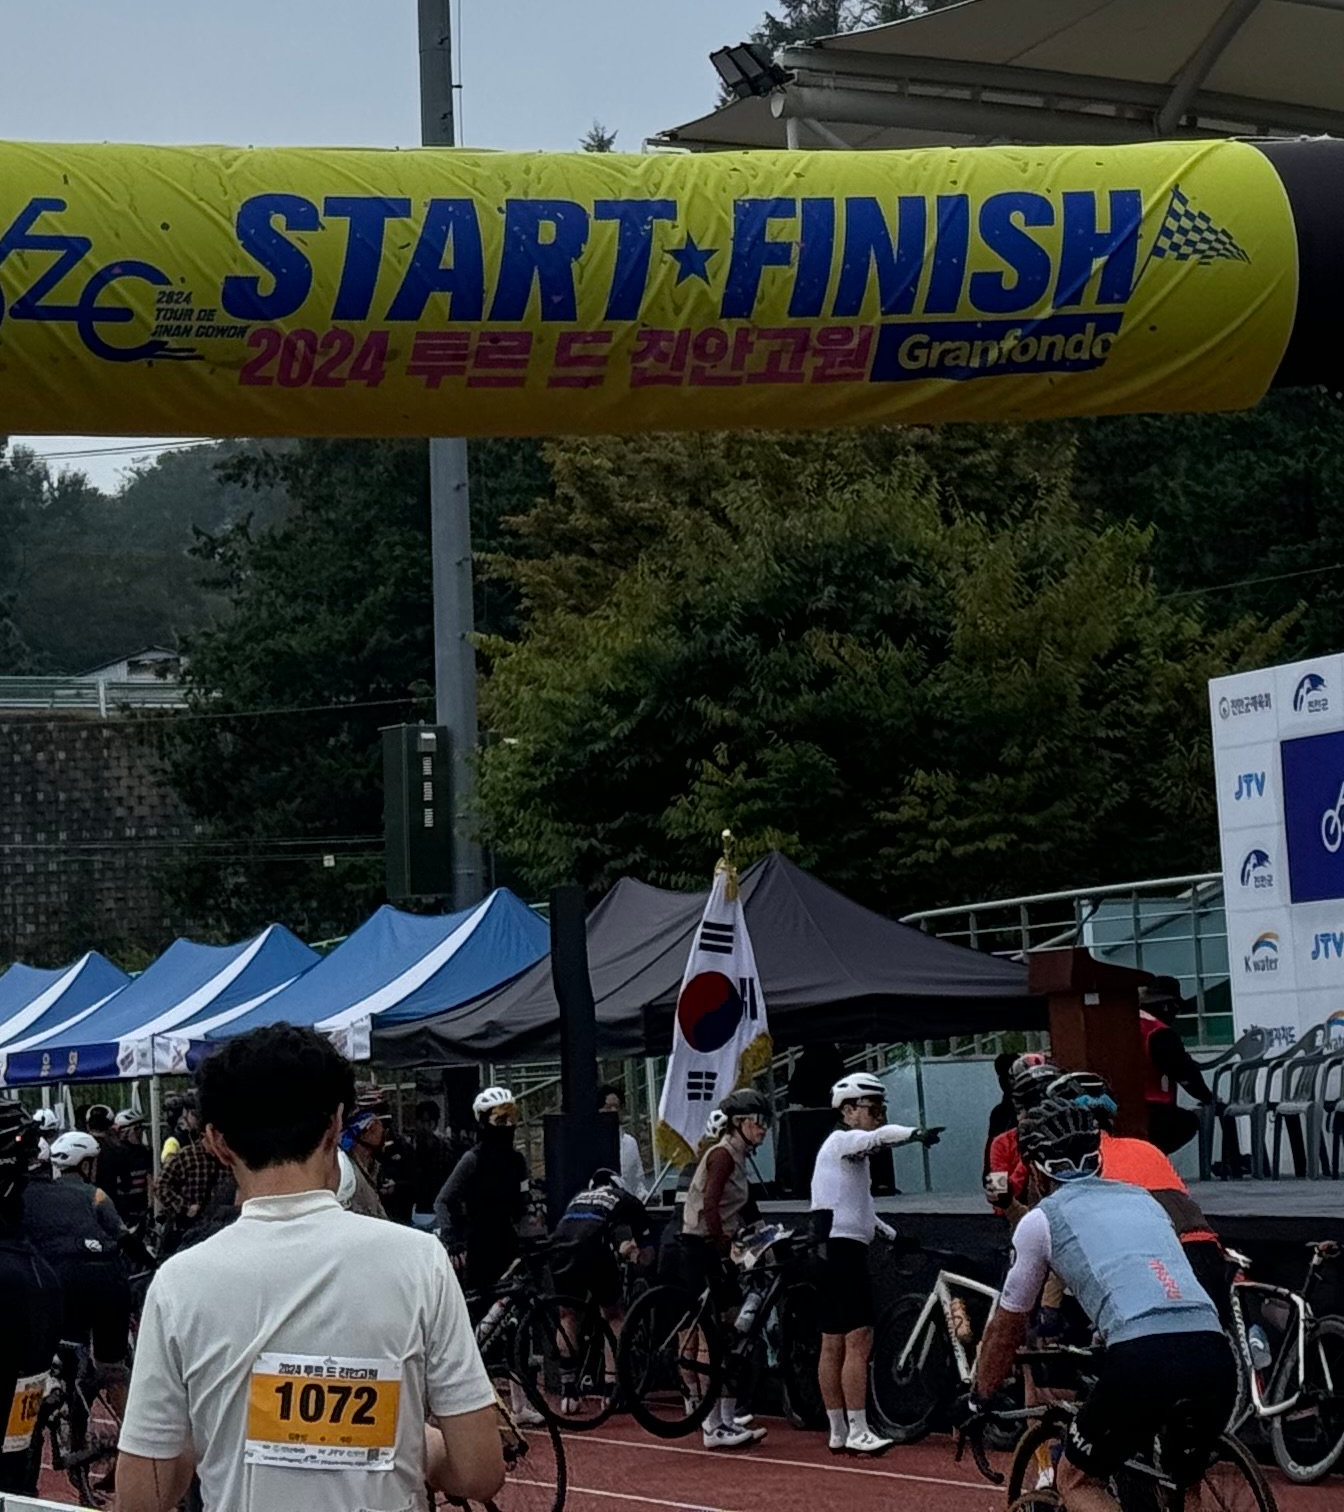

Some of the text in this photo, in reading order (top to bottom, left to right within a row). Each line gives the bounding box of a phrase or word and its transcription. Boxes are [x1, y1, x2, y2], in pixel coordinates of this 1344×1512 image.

[222, 188, 1141, 322] START FINISH
[155, 307, 217, 321] TOUR DE
[156, 290, 193, 304] 2024
[238, 325, 875, 389] 2024 투르 드 진안고원
[897, 323, 1117, 370] Granfondo
[1234, 771, 1266, 801] JTV
[1253, 955, 1279, 972] water
[274, 1381, 378, 1425] 1072
